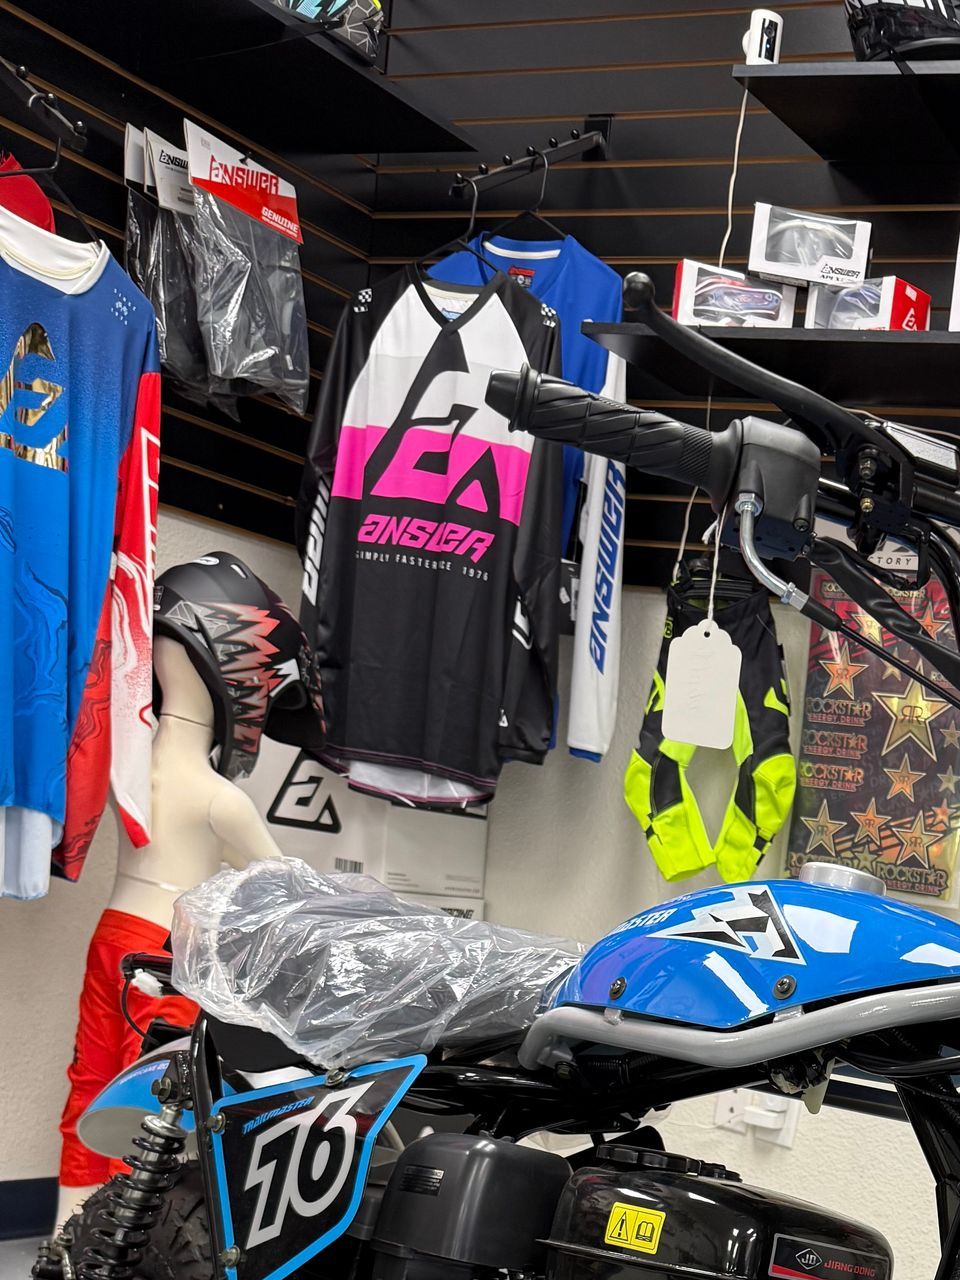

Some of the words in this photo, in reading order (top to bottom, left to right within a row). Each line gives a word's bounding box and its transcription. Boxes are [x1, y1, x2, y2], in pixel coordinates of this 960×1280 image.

[160, 150, 188, 169] ANSW
[210, 154, 280, 194] ANSWER
[261, 205, 299, 232] GENUINE
[589, 457, 627, 675] ANSWER
[877, 863, 948, 888] ROCKSTAR
[242, 1096, 316, 1135] TRAILMASTER
[801, 1253, 817, 1265] JD
